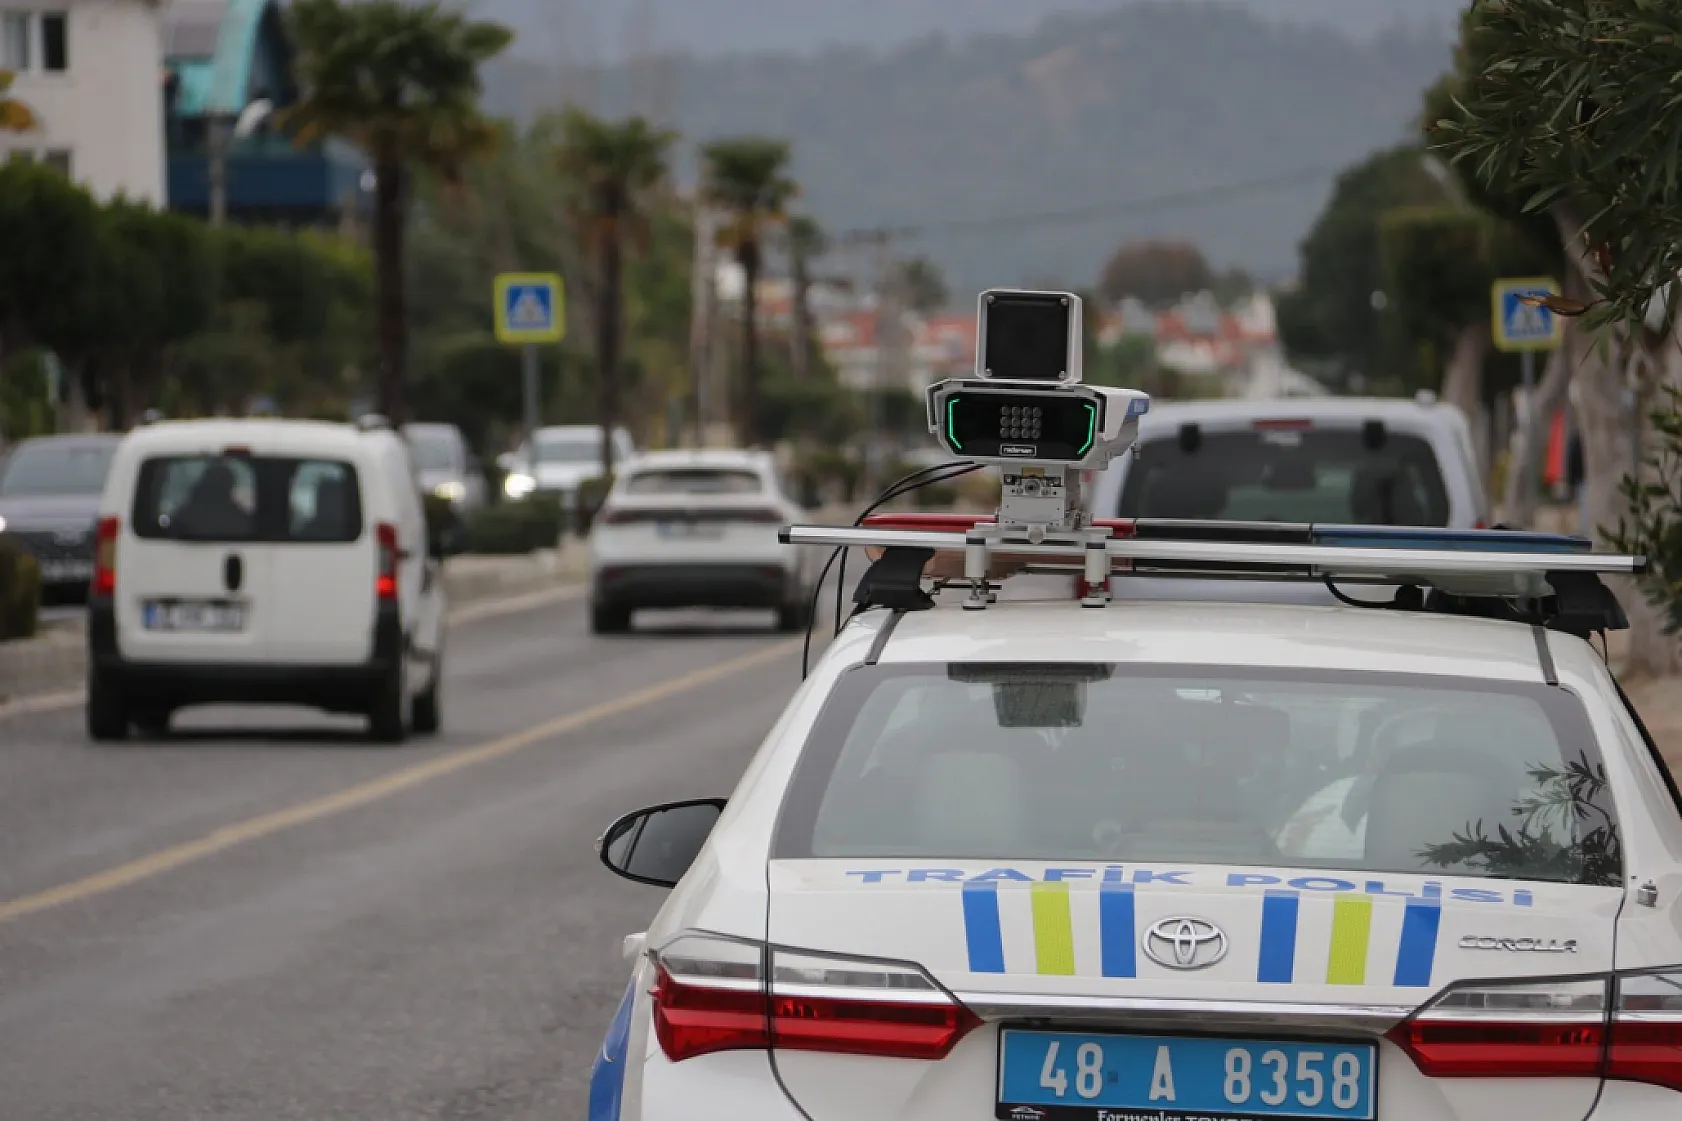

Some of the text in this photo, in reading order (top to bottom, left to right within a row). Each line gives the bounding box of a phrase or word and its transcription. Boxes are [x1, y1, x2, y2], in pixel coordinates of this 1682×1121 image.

[845, 865, 1533, 907] TRAFİK POLİSİ
[1458, 935, 1578, 954] COROLLA
[1040, 1041, 1361, 1109] 48 A 8358
